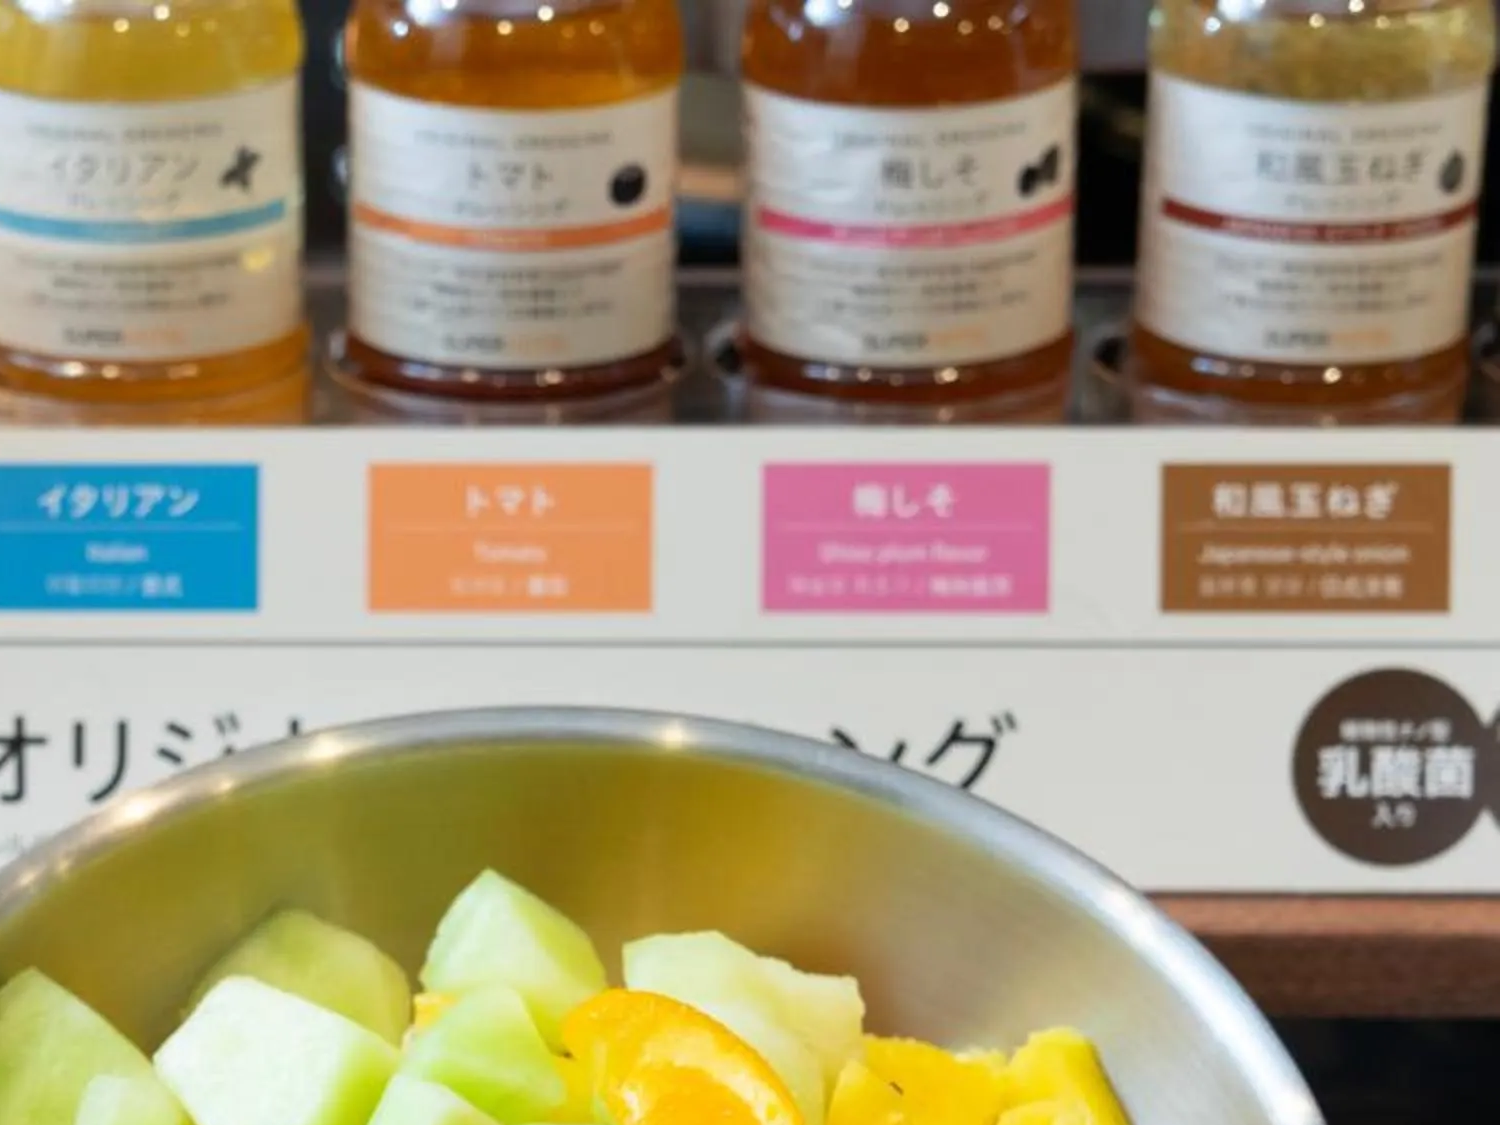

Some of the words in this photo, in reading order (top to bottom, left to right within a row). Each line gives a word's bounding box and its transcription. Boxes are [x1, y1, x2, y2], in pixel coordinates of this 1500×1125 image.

[467, 161, 553, 191] トマト
[36, 484, 199, 519] イタリアン
[464, 484, 557, 519] トマト
[853, 484, 958, 519] 梅しそ
[1212, 482, 1398, 519] 和風玉ねぎ
[1318, 745, 1476, 799] 乳酸菌
